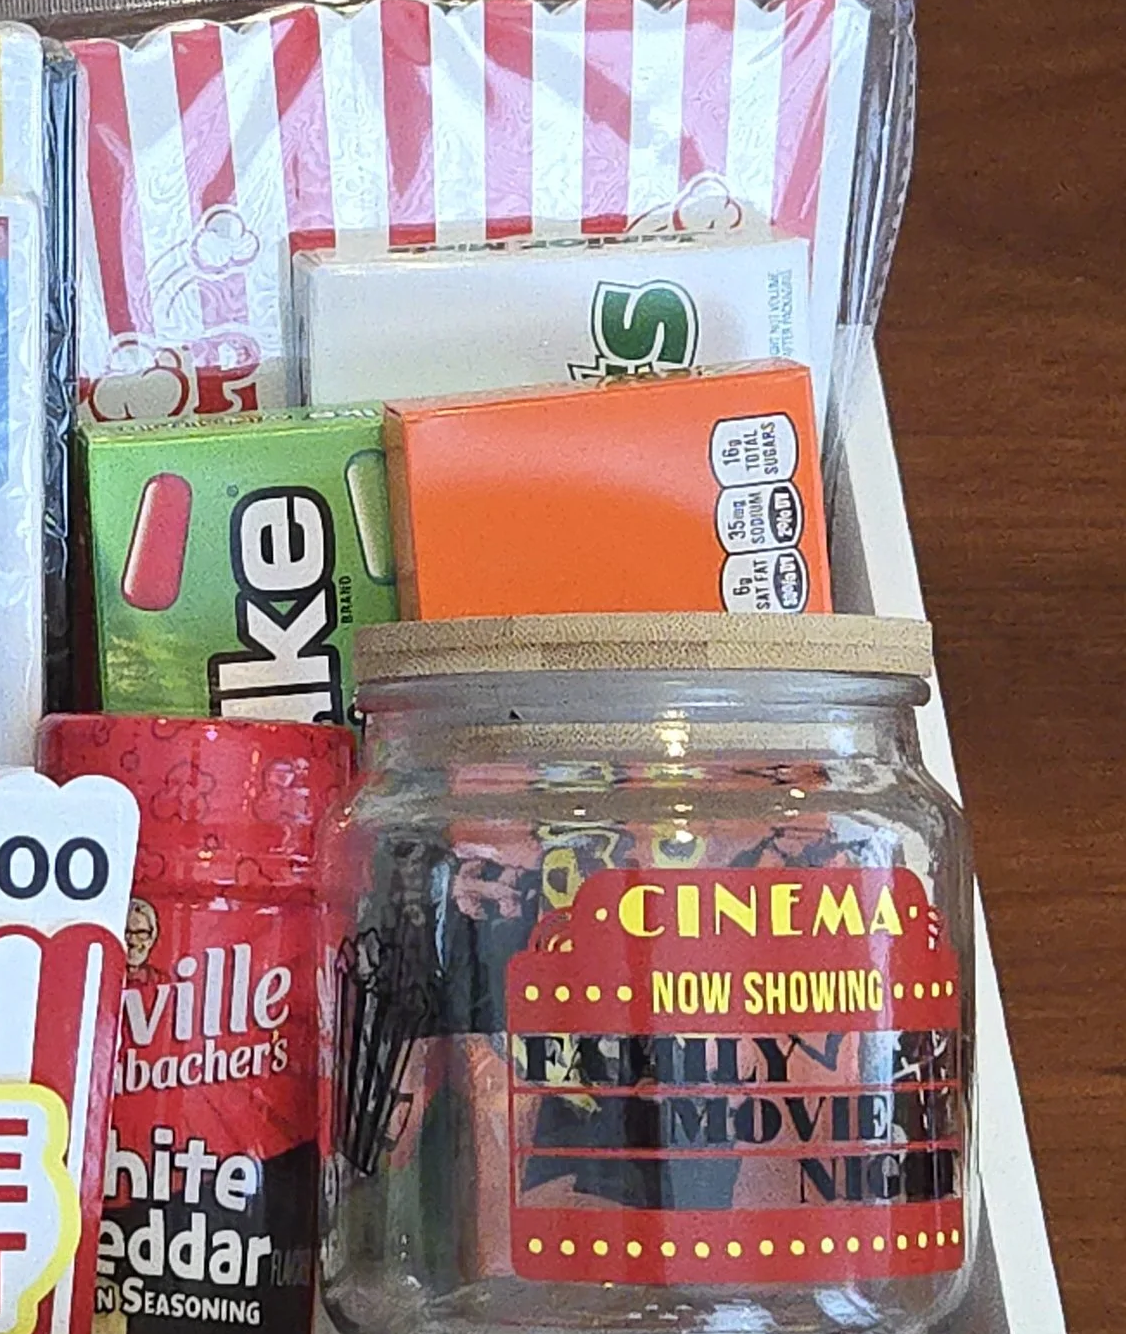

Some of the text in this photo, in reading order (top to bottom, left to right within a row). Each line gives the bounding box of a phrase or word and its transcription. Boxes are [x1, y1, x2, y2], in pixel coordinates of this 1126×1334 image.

[722, 439, 743, 466] 16g
[744, 429, 760, 472] TOTAL
[761, 421, 779, 475] SUGARS
[728, 500, 747, 540] 35mg
[749, 491, 766, 544] SODIUM
[775, 492, 794, 539] 2% DV
[338, 575, 354, 625] BRAND
[733, 576, 753, 596] 6g
[753, 559, 771, 610] SAT FAT
[618, 882, 904, 939] CINEMA
[651, 968, 885, 1016] NOW SHOWING
[670, 1094, 892, 1146] MOVIE
